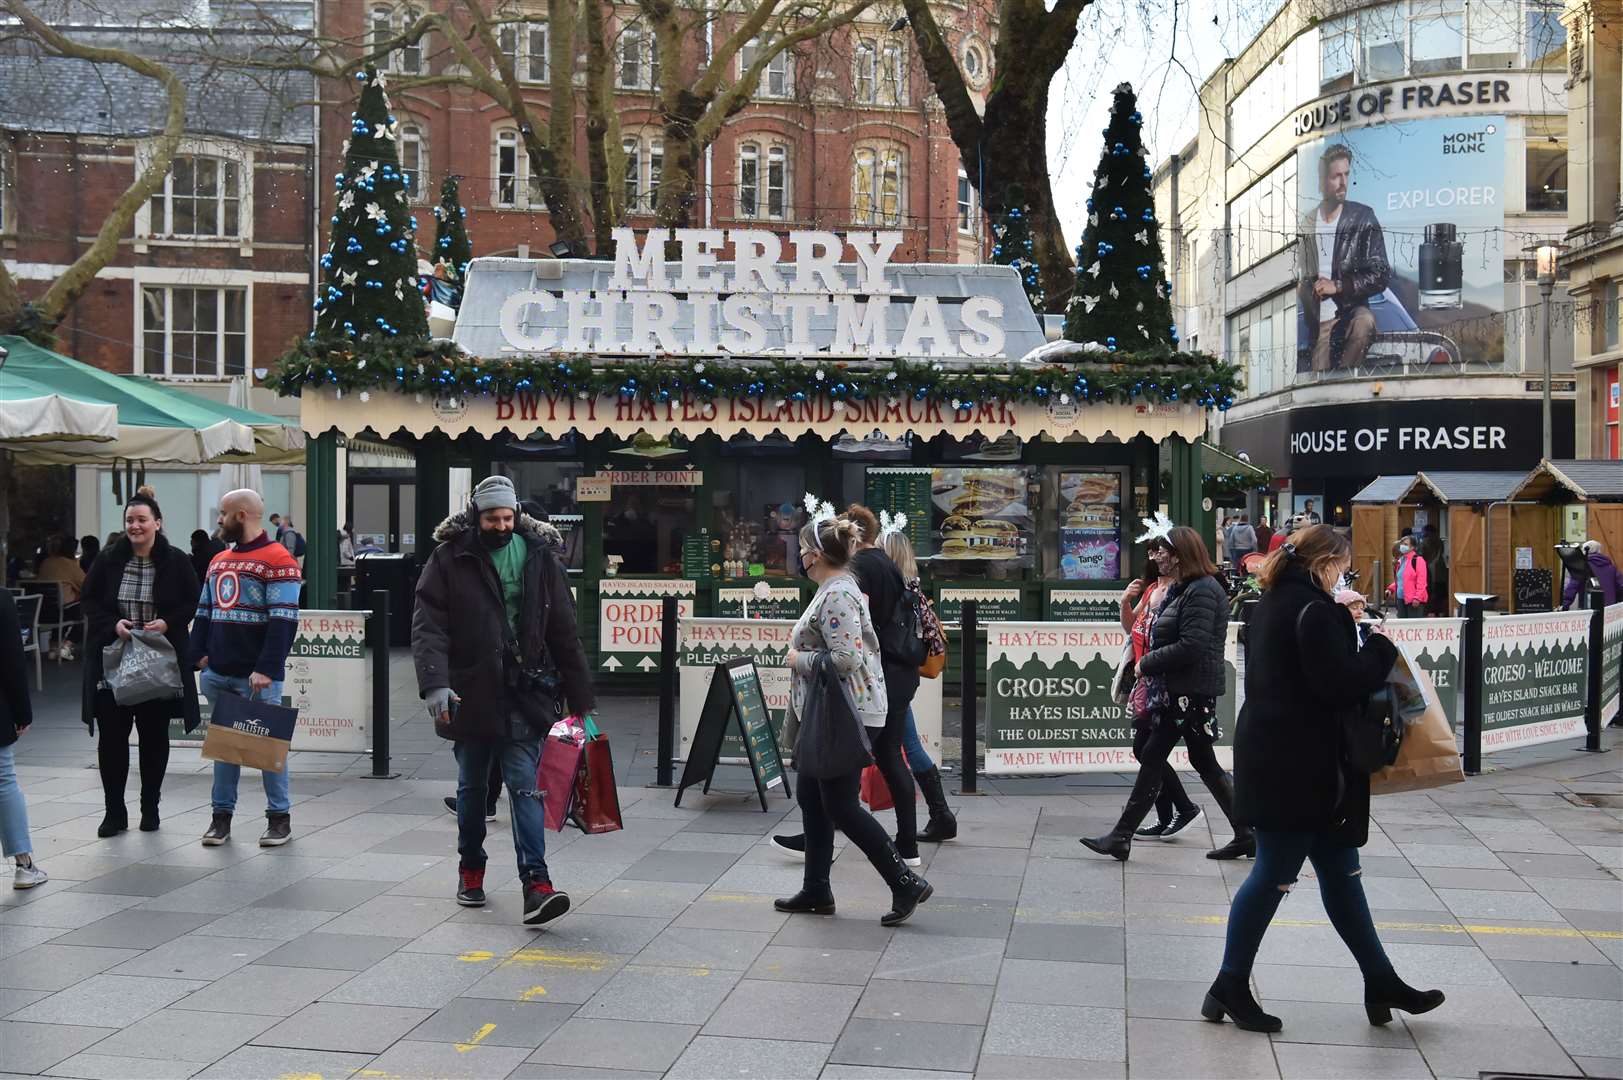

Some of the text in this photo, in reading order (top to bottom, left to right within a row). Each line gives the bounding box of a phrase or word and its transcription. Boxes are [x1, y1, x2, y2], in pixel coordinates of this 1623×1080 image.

[1294, 80, 1510, 136] HOUSE OF FRASER
[1443, 132, 1484, 144] MONT
[1442, 142, 1486, 155] BLANC
[1386, 186, 1496, 211] EXPLORER
[609, 227, 903, 294] MERRY
[500, 288, 1006, 358] CHRISTMAS
[616, 392, 718, 422] HAYES
[728, 393, 836, 423] ISLAND
[844, 394, 944, 424] SNACK
[953, 395, 1016, 427] BAR
[1290, 426, 1506, 455] HOUSE OF FRASER
[600, 471, 698, 483] ORDER POINT
[1078, 553, 1103, 565] Tango
[320, 618, 354, 633] BAR
[692, 625, 793, 641] HAYES ISLA
[1427, 627, 1453, 641] BAR
[1487, 619, 1586, 639] HAYES ISLAND SNACK BAR
[612, 627, 664, 645] POIN
[998, 630, 1124, 647] HAYES ISLAND
[301, 644, 360, 656] DISTANCE
[1484, 663, 1526, 685] CROESO
[1534, 657, 1584, 679] WELCOME
[997, 677, 1090, 698] CROESO
[1489, 682, 1578, 705] HAYES ISLAND SNACK BAR
[1010, 704, 1062, 720] HAYES
[1066, 706, 1121, 720] ISLAND
[1484, 700, 1581, 725] THE OLDEST SNACK BAR IN WALES
[233, 720, 270, 737] HOLLISTER
[309, 727, 338, 737] POINT
[998, 729, 1024, 741] THE
[1027, 728, 1078, 741] OLDEST
[1081, 728, 1127, 740] SNACK
[1505, 729, 1521, 743] WITH
[1522, 726, 1538, 739] LOVE
[1048, 750, 1084, 765] WITH
[1087, 750, 1126, 764] LOVE
